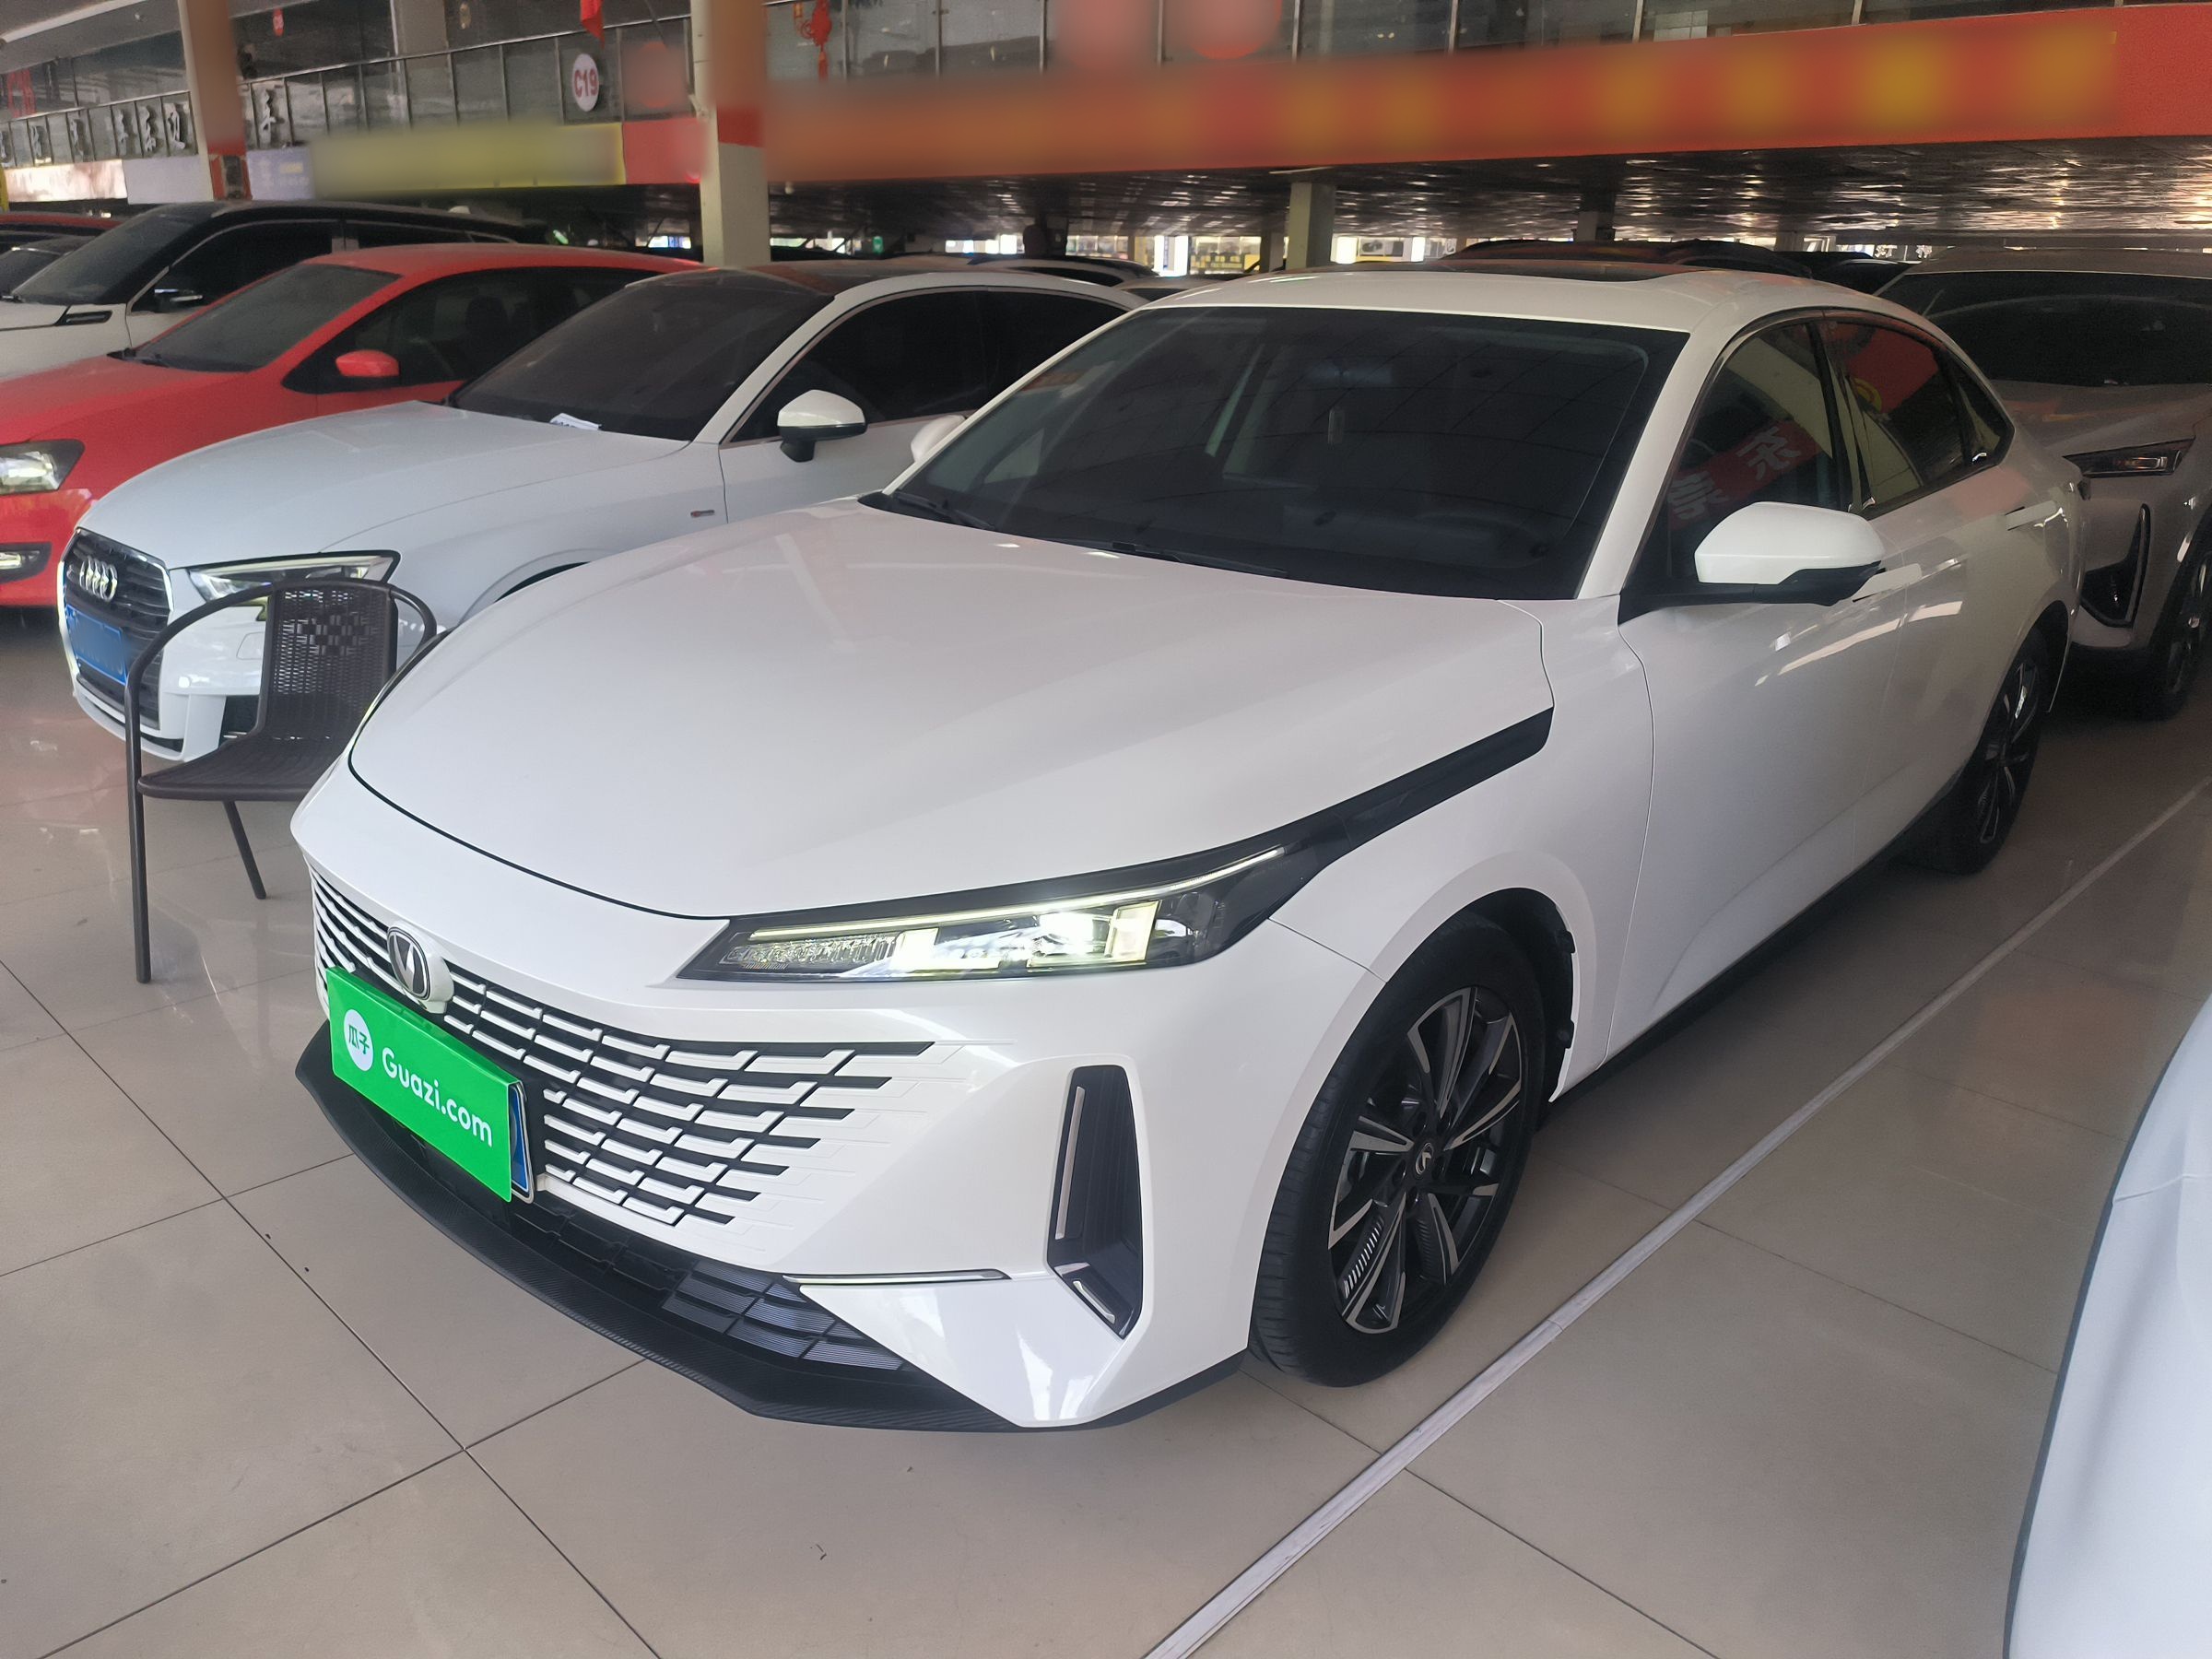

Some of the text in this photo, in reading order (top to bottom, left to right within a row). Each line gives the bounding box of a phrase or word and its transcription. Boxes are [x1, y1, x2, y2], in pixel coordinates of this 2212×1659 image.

[574, 69, 598, 98] C19
[348, 1024, 371, 1055] 瓜子
[382, 1047, 493, 1148] Guazi.com
